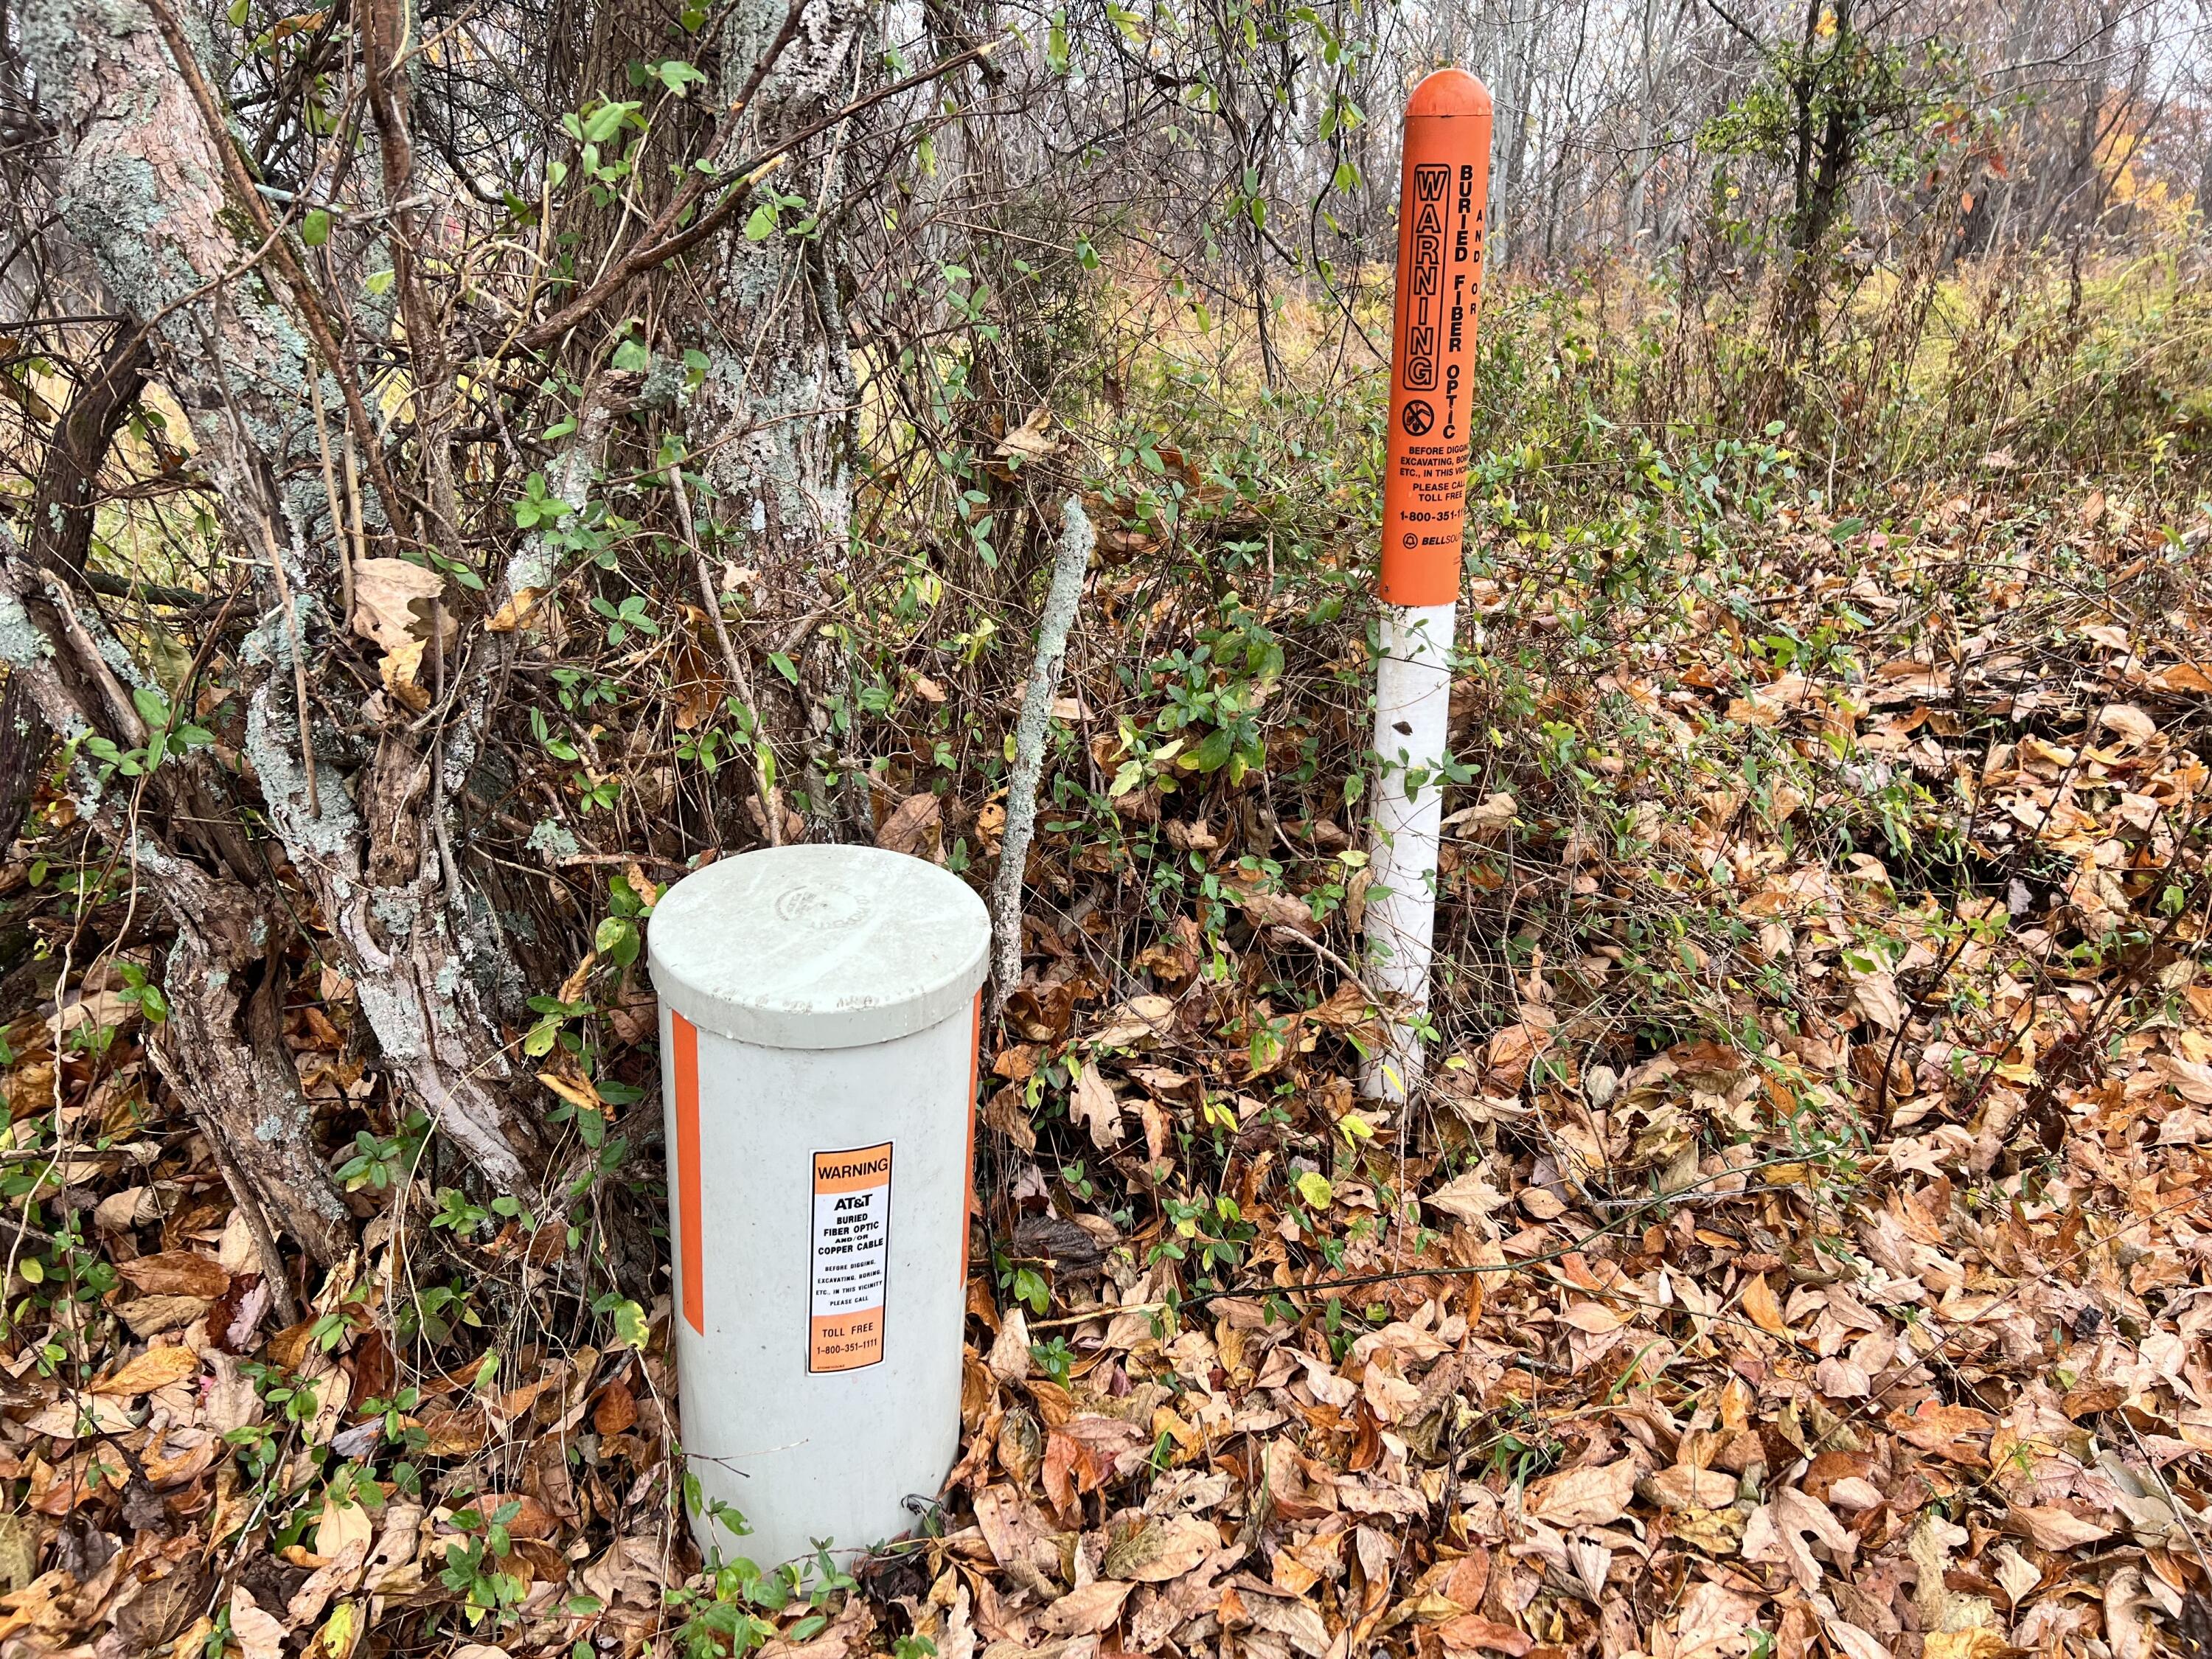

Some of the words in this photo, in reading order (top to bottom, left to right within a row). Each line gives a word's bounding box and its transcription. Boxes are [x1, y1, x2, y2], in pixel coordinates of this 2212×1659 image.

[1454, 164, 1473, 262] BURIED
[1473, 209, 1483, 263] AND
[1408, 170, 1448, 386] WARNING
[1470, 282, 1478, 316] OR
[1448, 274, 1466, 352] FIBER
[1442, 364, 1460, 439] OPTIC
[1408, 446, 1444, 455] BEFORE
[1400, 456, 1454, 467] EXCAVATING,
[1399, 467, 1421, 479] ETC.,
[1423, 468, 1433, 478] IN
[1436, 467, 1453, 477] THIS
[1412, 481, 1450, 492] PLEASE
[1451, 480, 1466, 490] CALL
[1418, 493, 1443, 502] TOLL
[1445, 490, 1463, 501] FREE
[818, 1158, 888, 1180] WARNING
[834, 1193, 873, 1211] AT&T
[836, 1213, 869, 1225] BURIED
[824, 1227, 849, 1237] FIBER
[853, 1221, 880, 1234] OPTIC
[818, 1245, 853, 1255] COPPER
[857, 1237, 884, 1251] CABLE
[835, 1234, 869, 1244] AND/OR
[858, 1280, 883, 1290] VICINITY
[830, 1298, 852, 1306] PLEASE
[822, 1327, 845, 1338] TOLL
[851, 1322, 874, 1335] FREE
[816, 1338, 877, 1354] 1-800-351-1111
